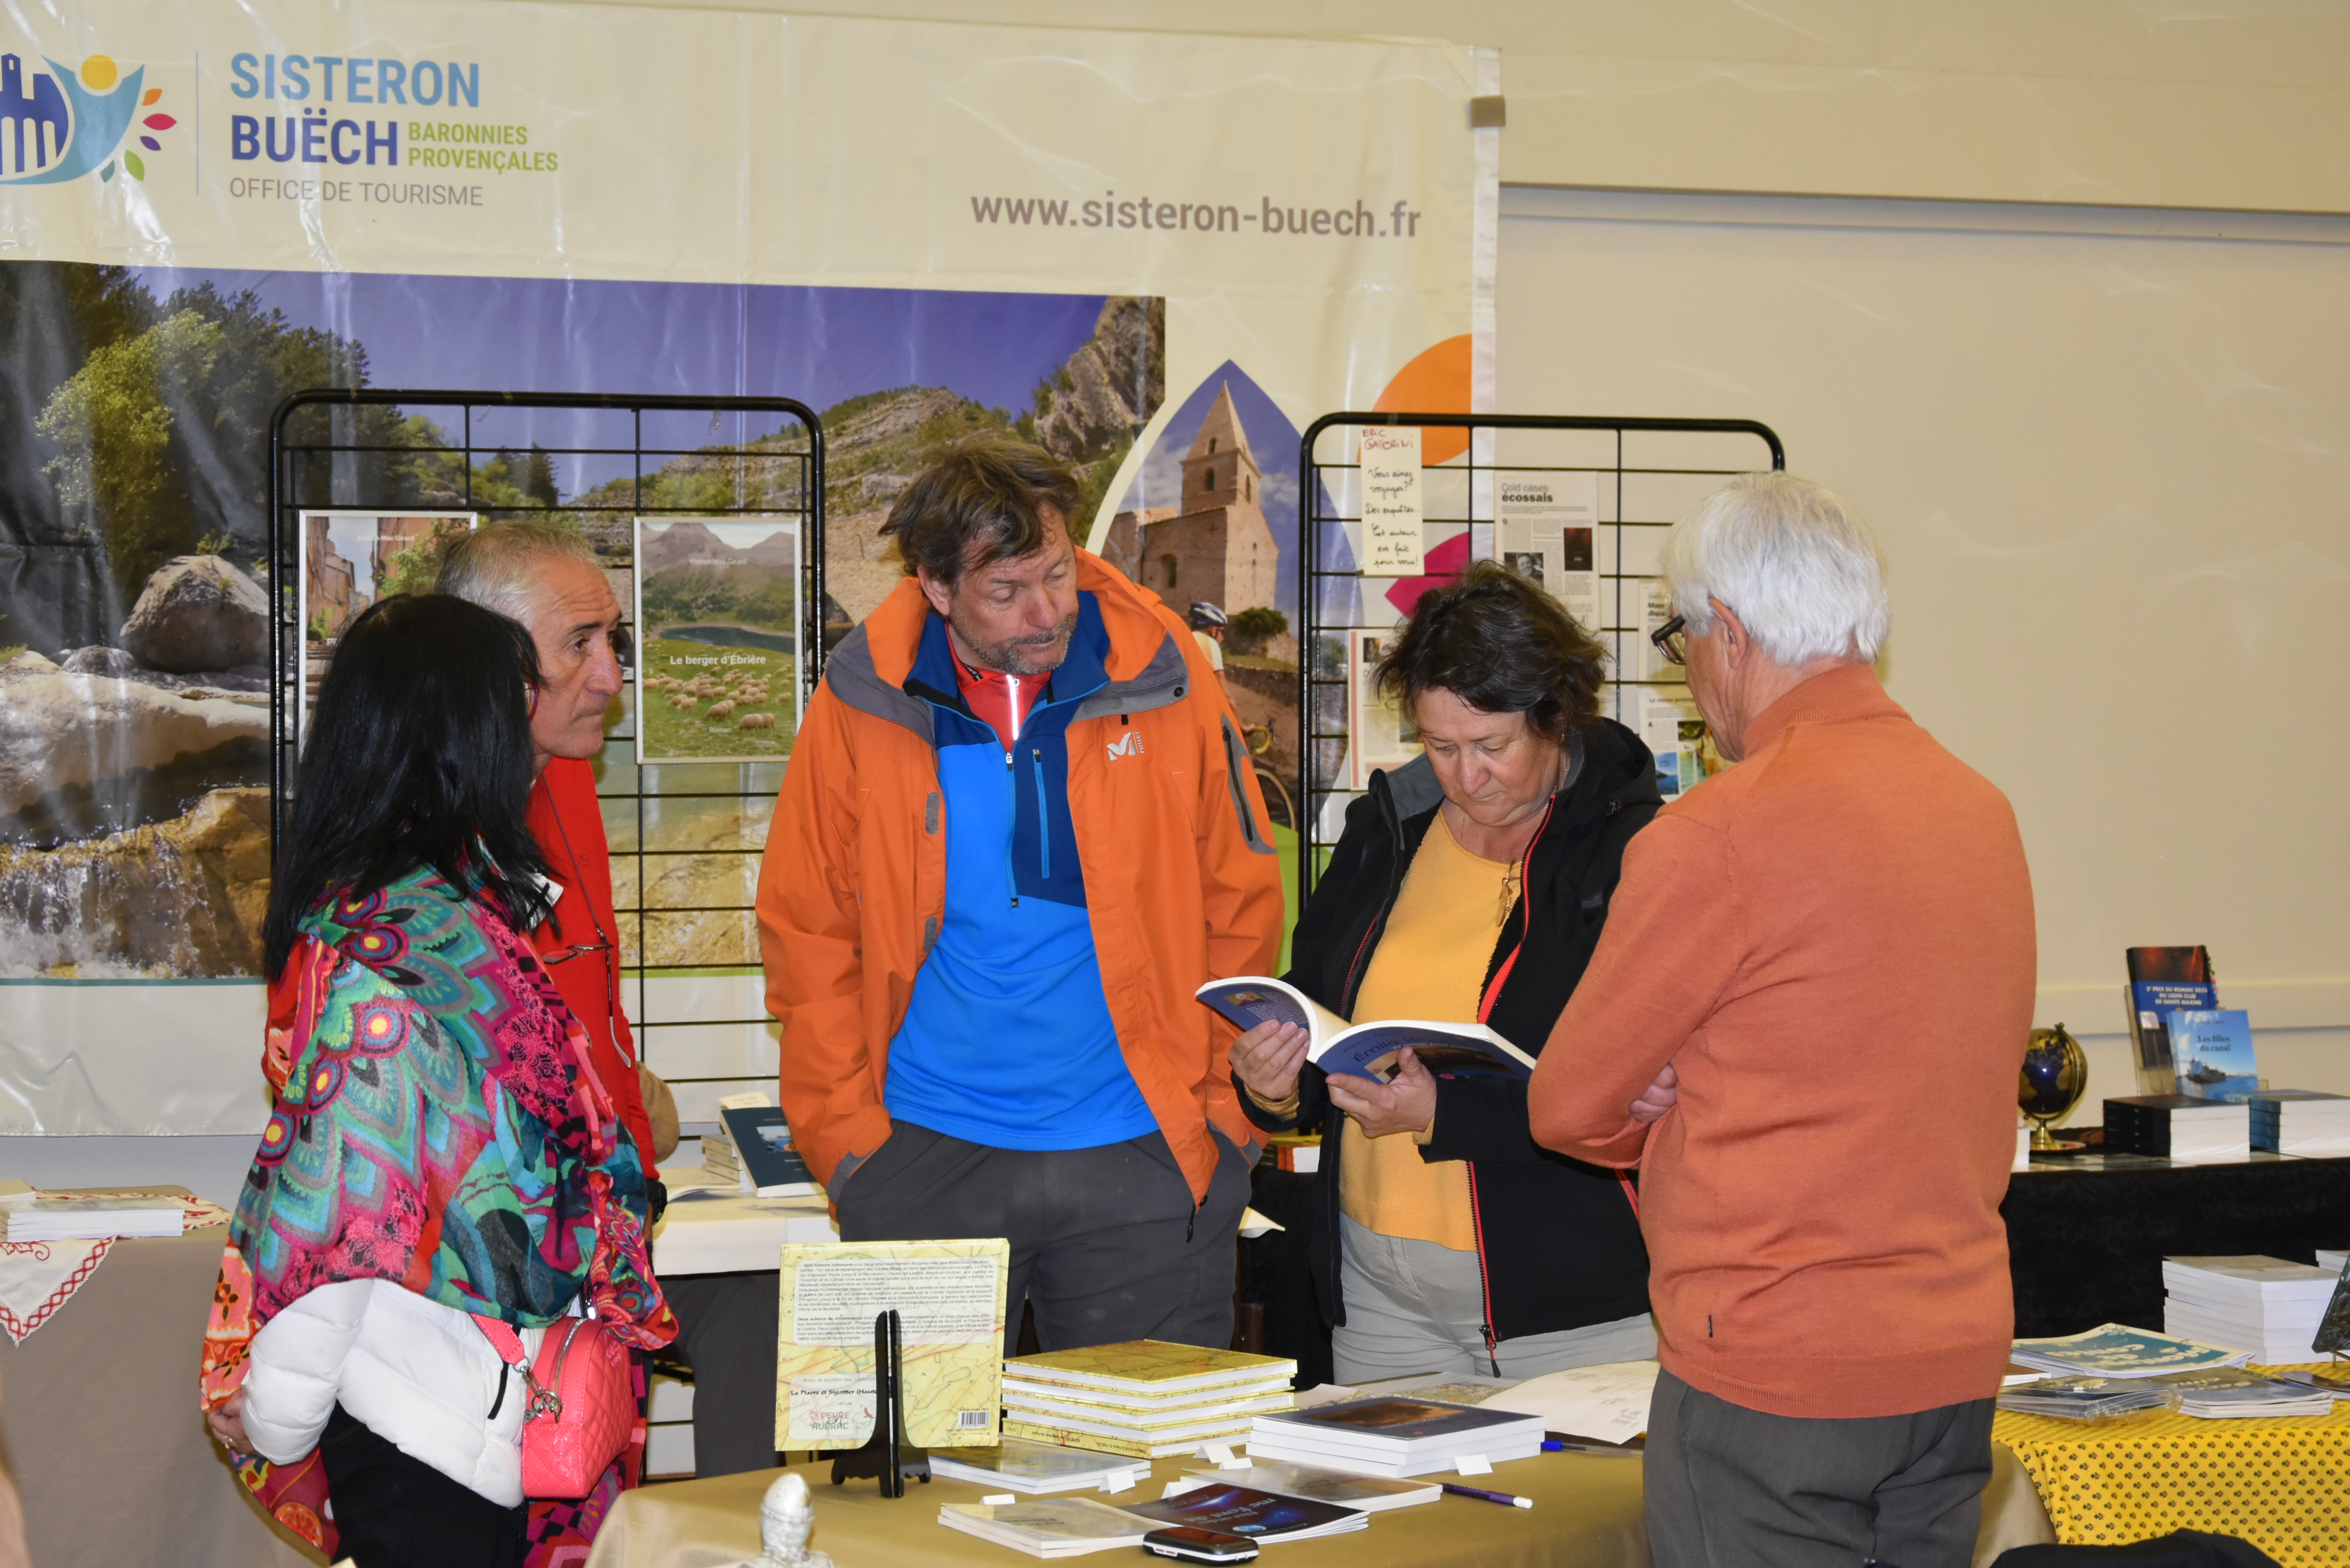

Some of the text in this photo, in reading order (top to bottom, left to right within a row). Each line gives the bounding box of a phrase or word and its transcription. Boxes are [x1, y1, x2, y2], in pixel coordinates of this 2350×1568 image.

[230, 52, 480, 107] SISTERON
[231, 107, 398, 166] BUËCH
[409, 121, 528, 145] BARONNIES
[409, 147, 559, 173] PROVENÇALES
[230, 177, 483, 206] OFFICE DE TOURISME
[972, 191, 1420, 237] www.sisteron-buech.fr
[1368, 467, 1413, 485] Vous aimez
[1502, 483, 1520, 492] Cold
[1502, 491, 1553, 502] écossais
[1365, 503, 1380, 515] Des
[1372, 523, 1385, 536] Cet
[1395, 543, 1409, 556] fait
[1374, 560, 1393, 568] pour
[670, 655, 682, 664] Le
[685, 655, 718, 666] berger
